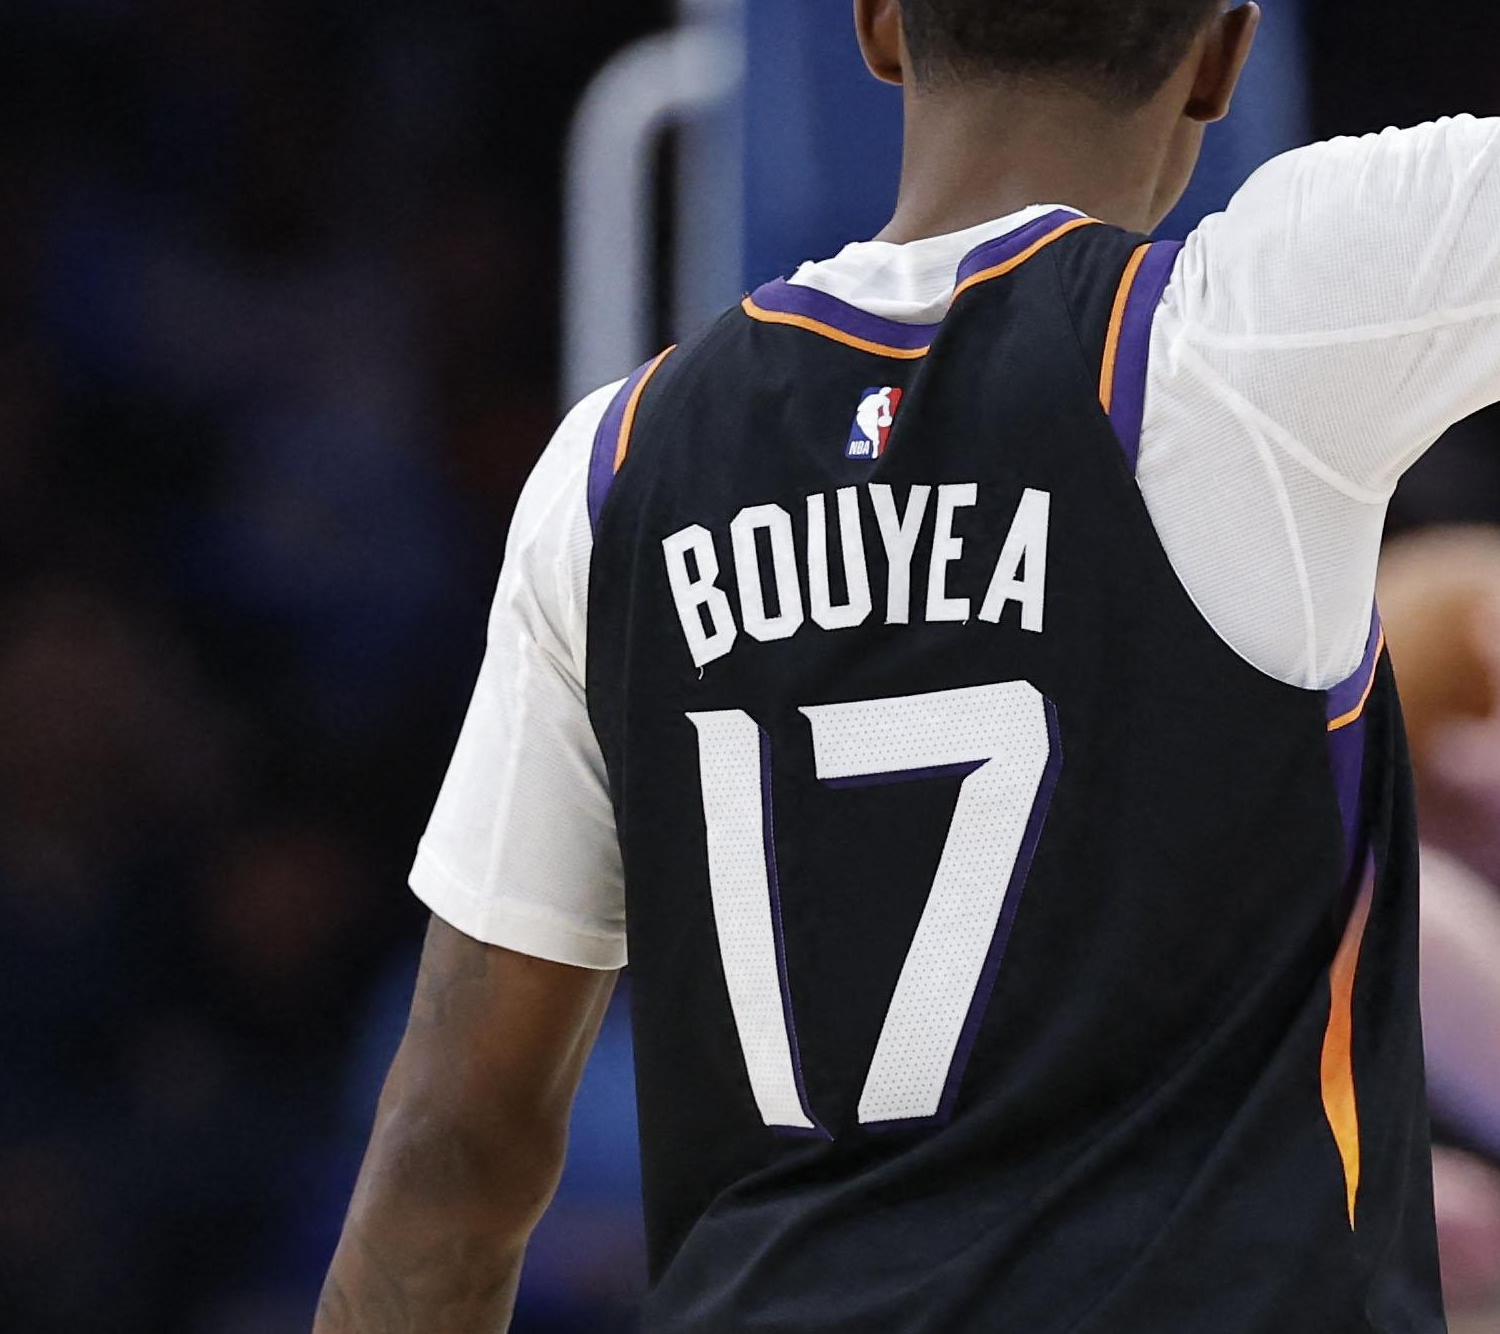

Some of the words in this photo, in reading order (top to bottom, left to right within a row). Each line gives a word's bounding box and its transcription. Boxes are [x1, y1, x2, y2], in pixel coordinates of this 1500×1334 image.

[848, 440, 871, 456] NBA
[661, 481, 1052, 669] BOUYEA
[684, 679, 1062, 1141] 17
